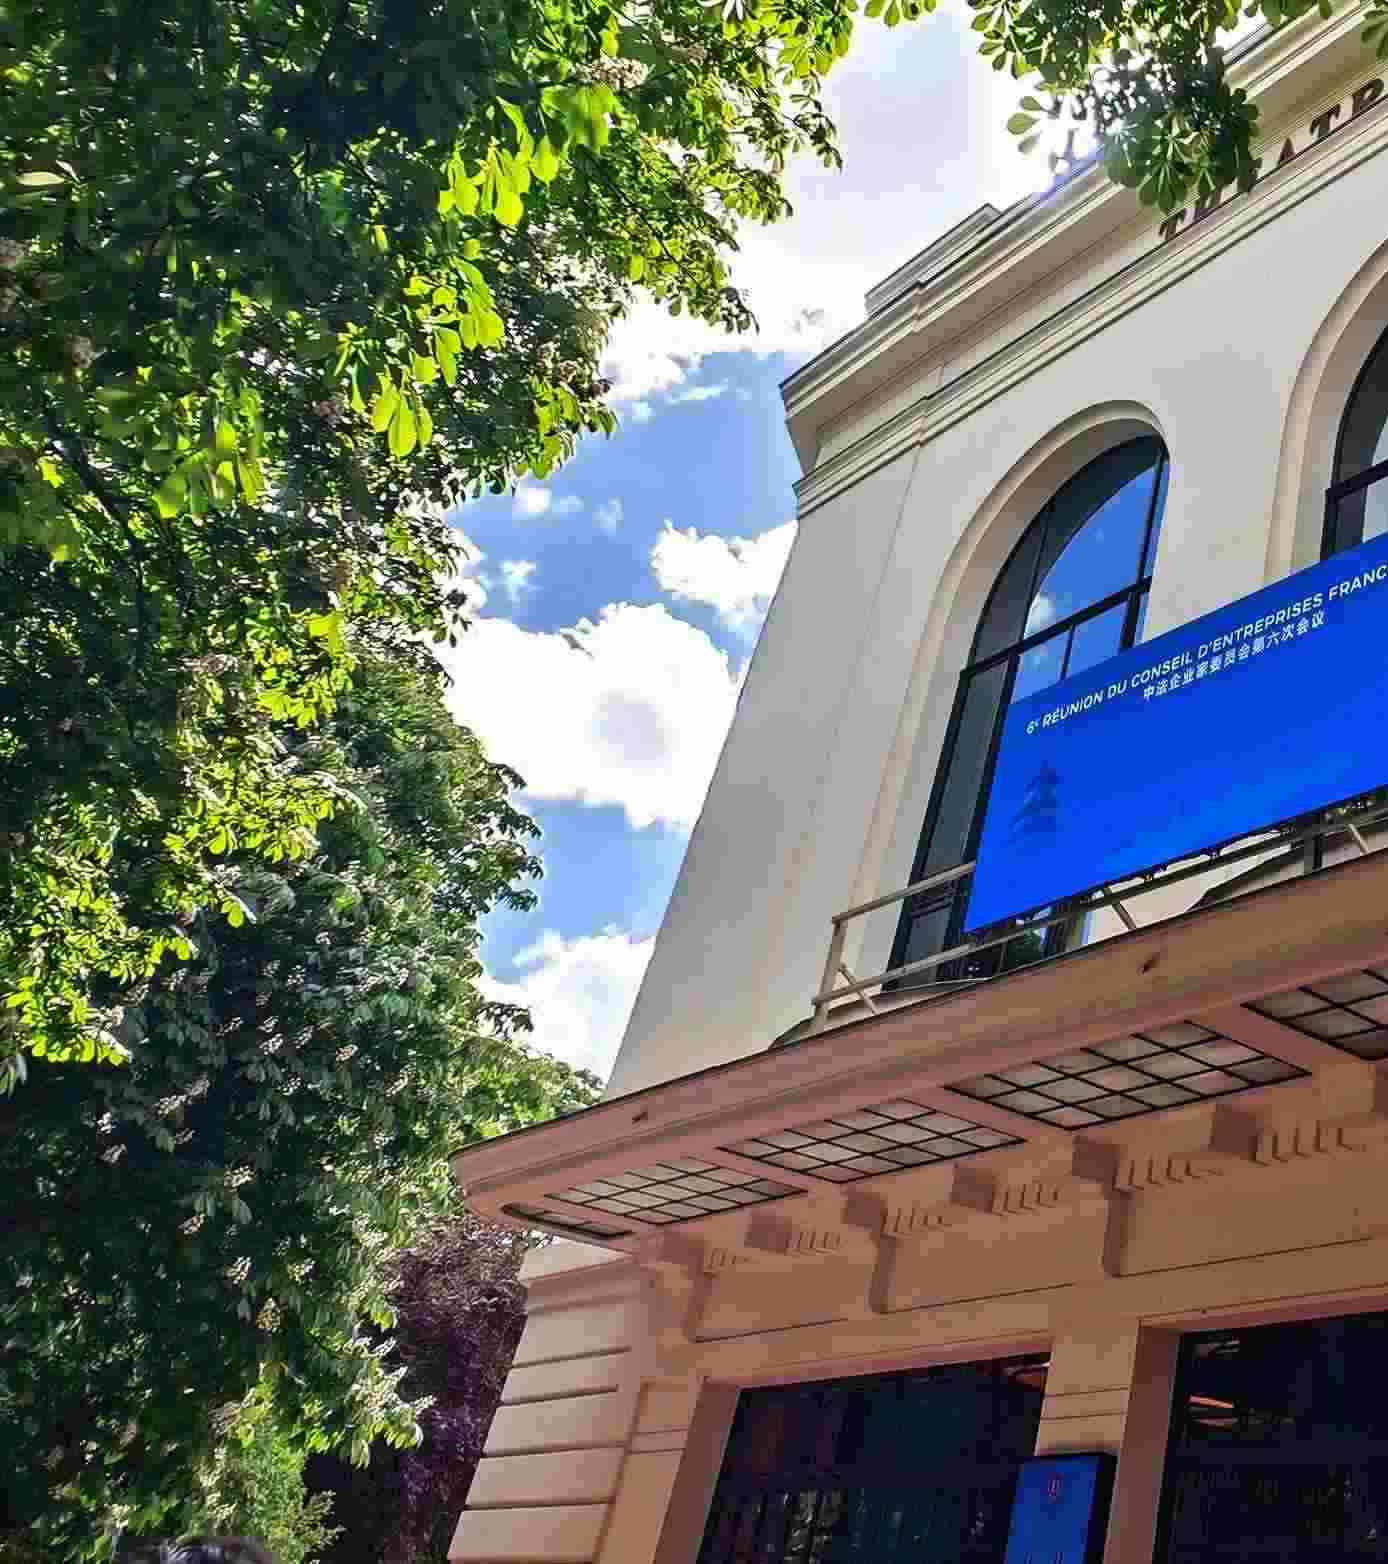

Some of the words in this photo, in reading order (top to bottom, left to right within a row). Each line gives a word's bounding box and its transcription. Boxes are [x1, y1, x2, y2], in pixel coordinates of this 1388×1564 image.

[1107, 680, 1128, 699] DU
[1131, 652, 1193, 688] CONSEIL
[1197, 593, 1323, 659] D'ENTREPRISES
